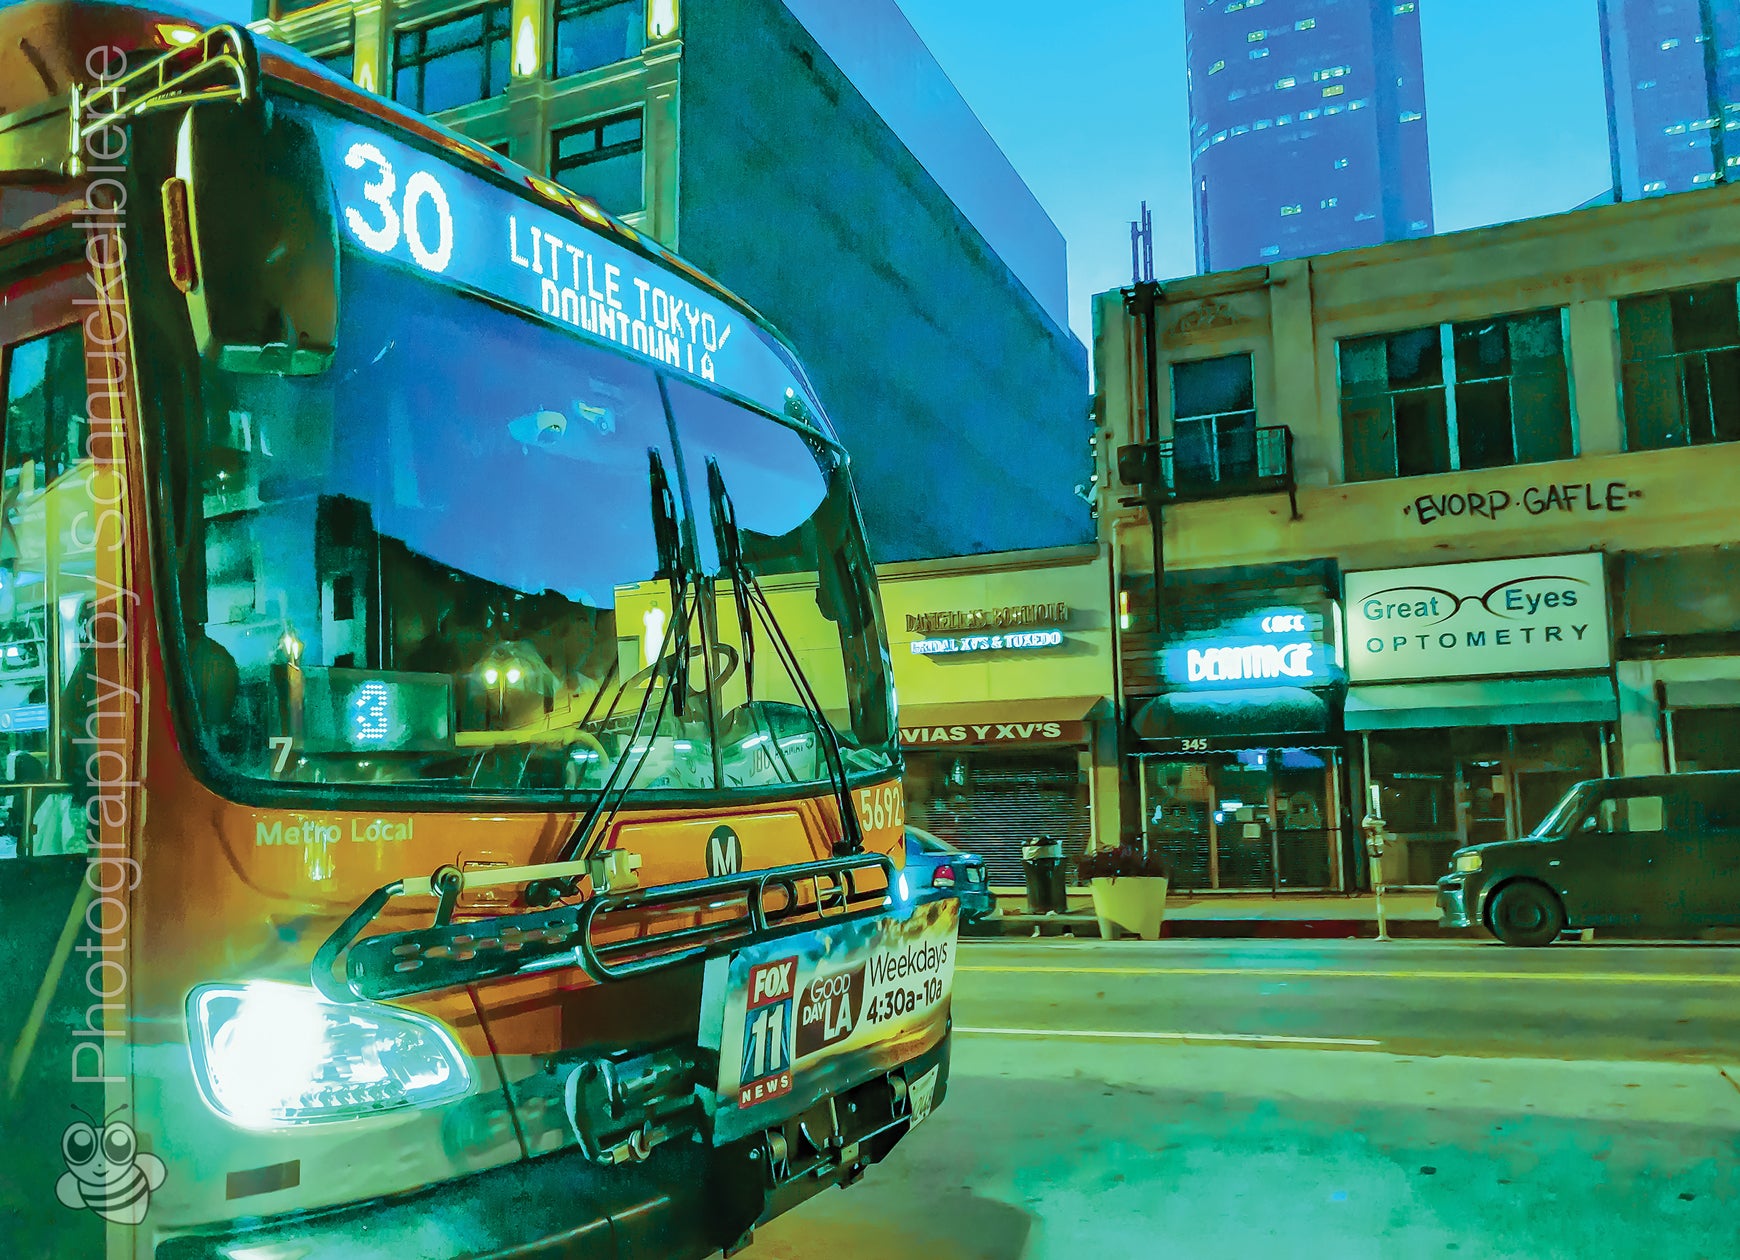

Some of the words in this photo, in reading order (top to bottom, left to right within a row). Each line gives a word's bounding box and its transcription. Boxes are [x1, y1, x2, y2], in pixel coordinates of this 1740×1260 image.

[345, 143, 453, 273] 30
[510, 214, 623, 308] LITTLE
[633, 277, 732, 353] TOKYO/
[541, 278, 680, 368] DOWNTOWN
[1363, 596, 1440, 621] Great
[1505, 588, 1578, 615] Eyes
[911, 637, 959, 654] BRIDAL
[991, 635, 1003, 649] &
[1003, 632, 1062, 649] TUXEDO
[1366, 624, 1589, 653] OPTOMETRY
[899, 727, 967, 743] VIAS
[971, 725, 992, 740] Y
[995, 722, 1062, 739] XV'S
[1181, 738, 1208, 751] 345
[268, 736, 294, 774] 7
[861, 786, 903, 832] 5692
[256, 819, 342, 847] Metro
[351, 817, 414, 843] Local
[711, 835, 738, 877] M
[753, 960, 792, 1004] FOX
[868, 940, 948, 988] Weekdays
[803, 1002, 827, 1026] DAY
[823, 993, 853, 1042] LA
[751, 1003, 784, 1078] 11
[741, 1074, 789, 1104] NEWS
